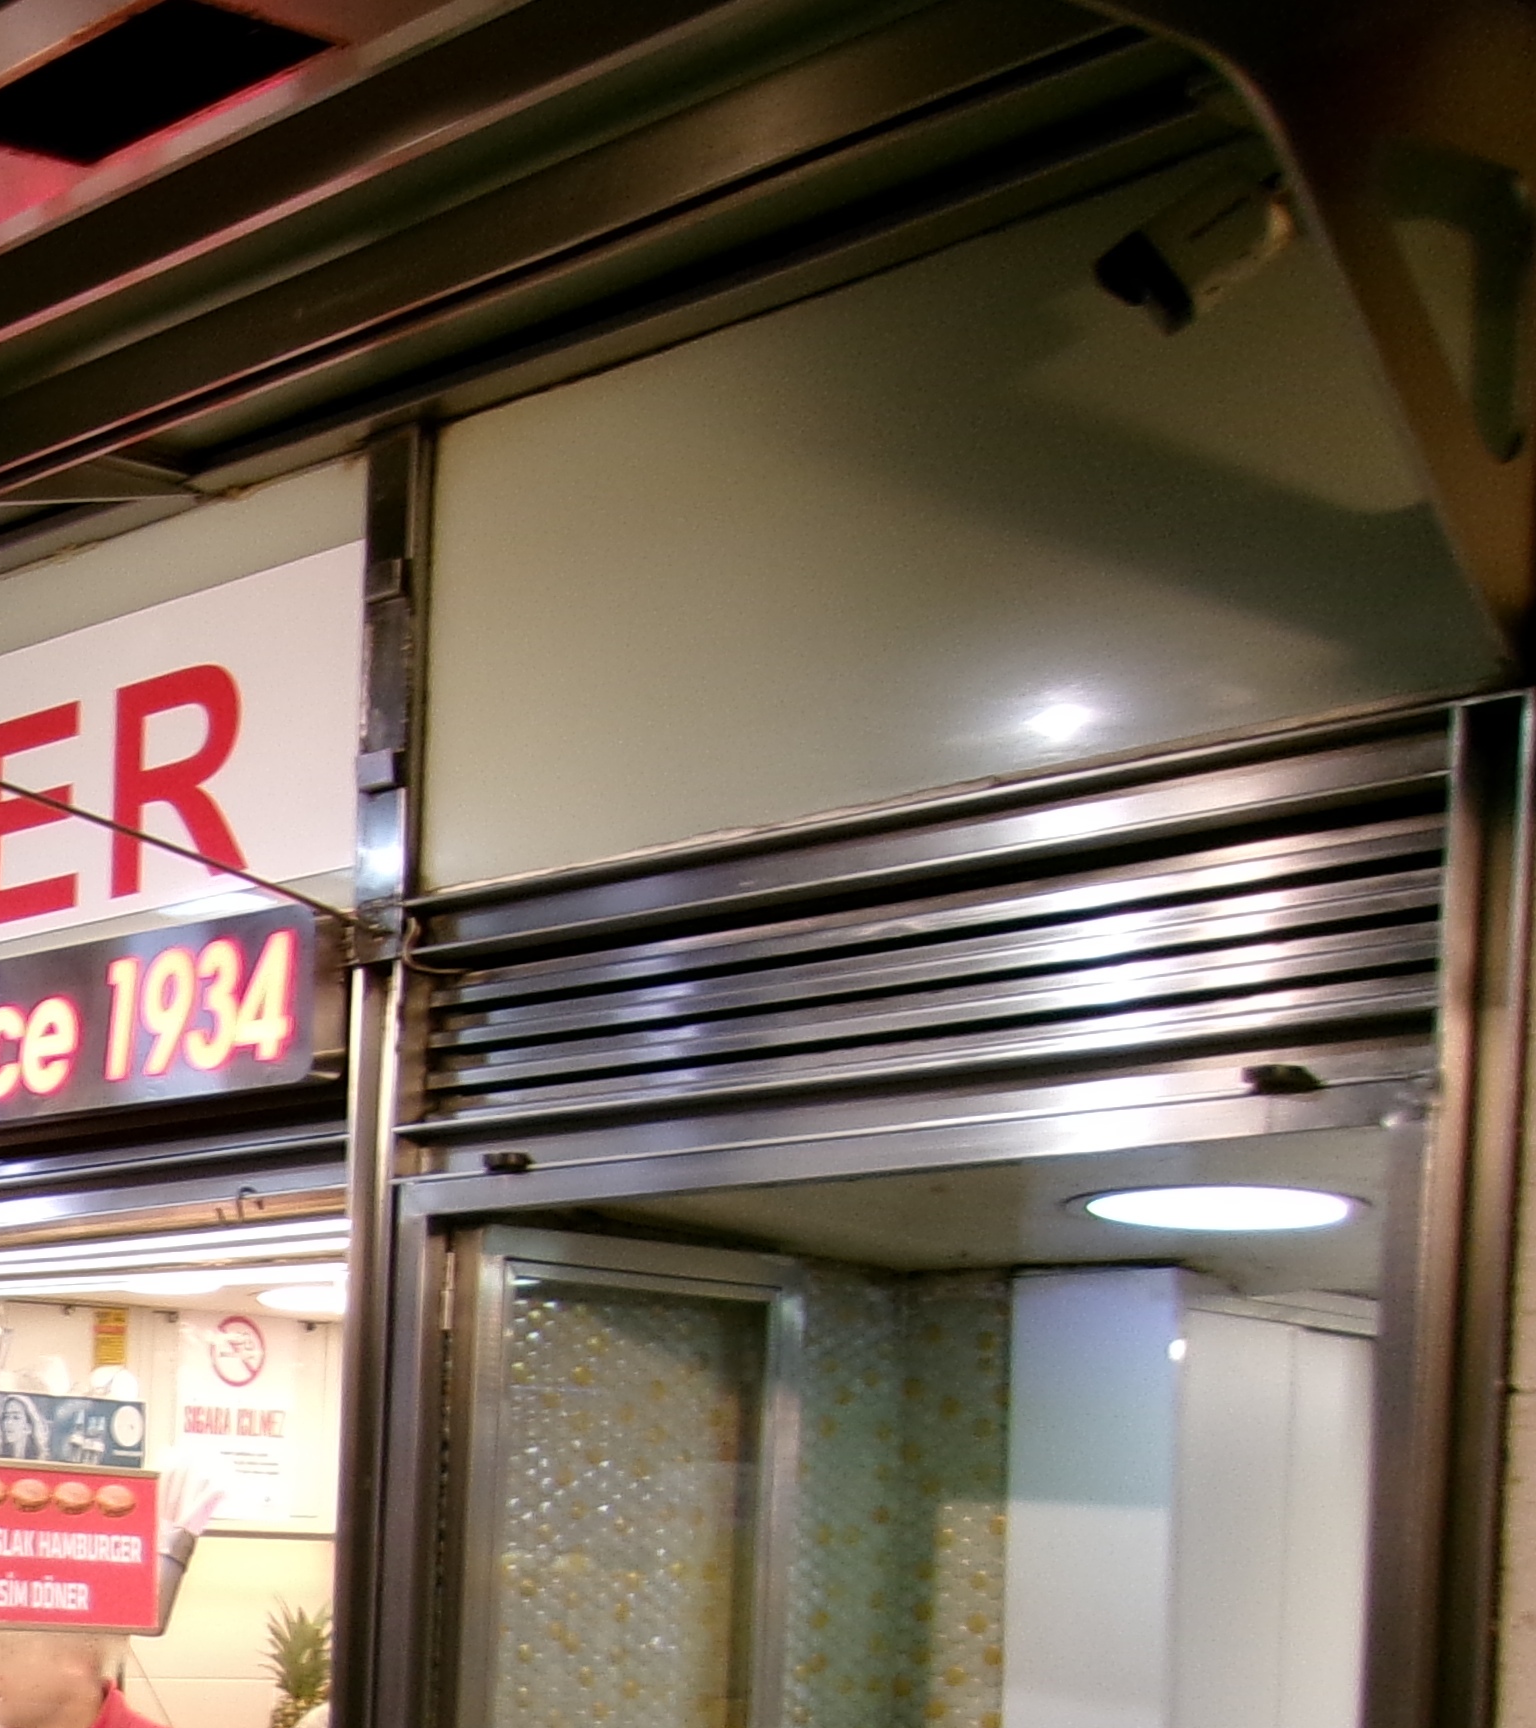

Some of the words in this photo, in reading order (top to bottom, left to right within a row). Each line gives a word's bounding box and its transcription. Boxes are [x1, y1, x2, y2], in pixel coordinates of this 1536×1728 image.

[104, 928, 298, 1083] 1934
[38, 1531, 143, 1564] HAMBURGER
[32, 1575, 89, 1610] DÖNER
